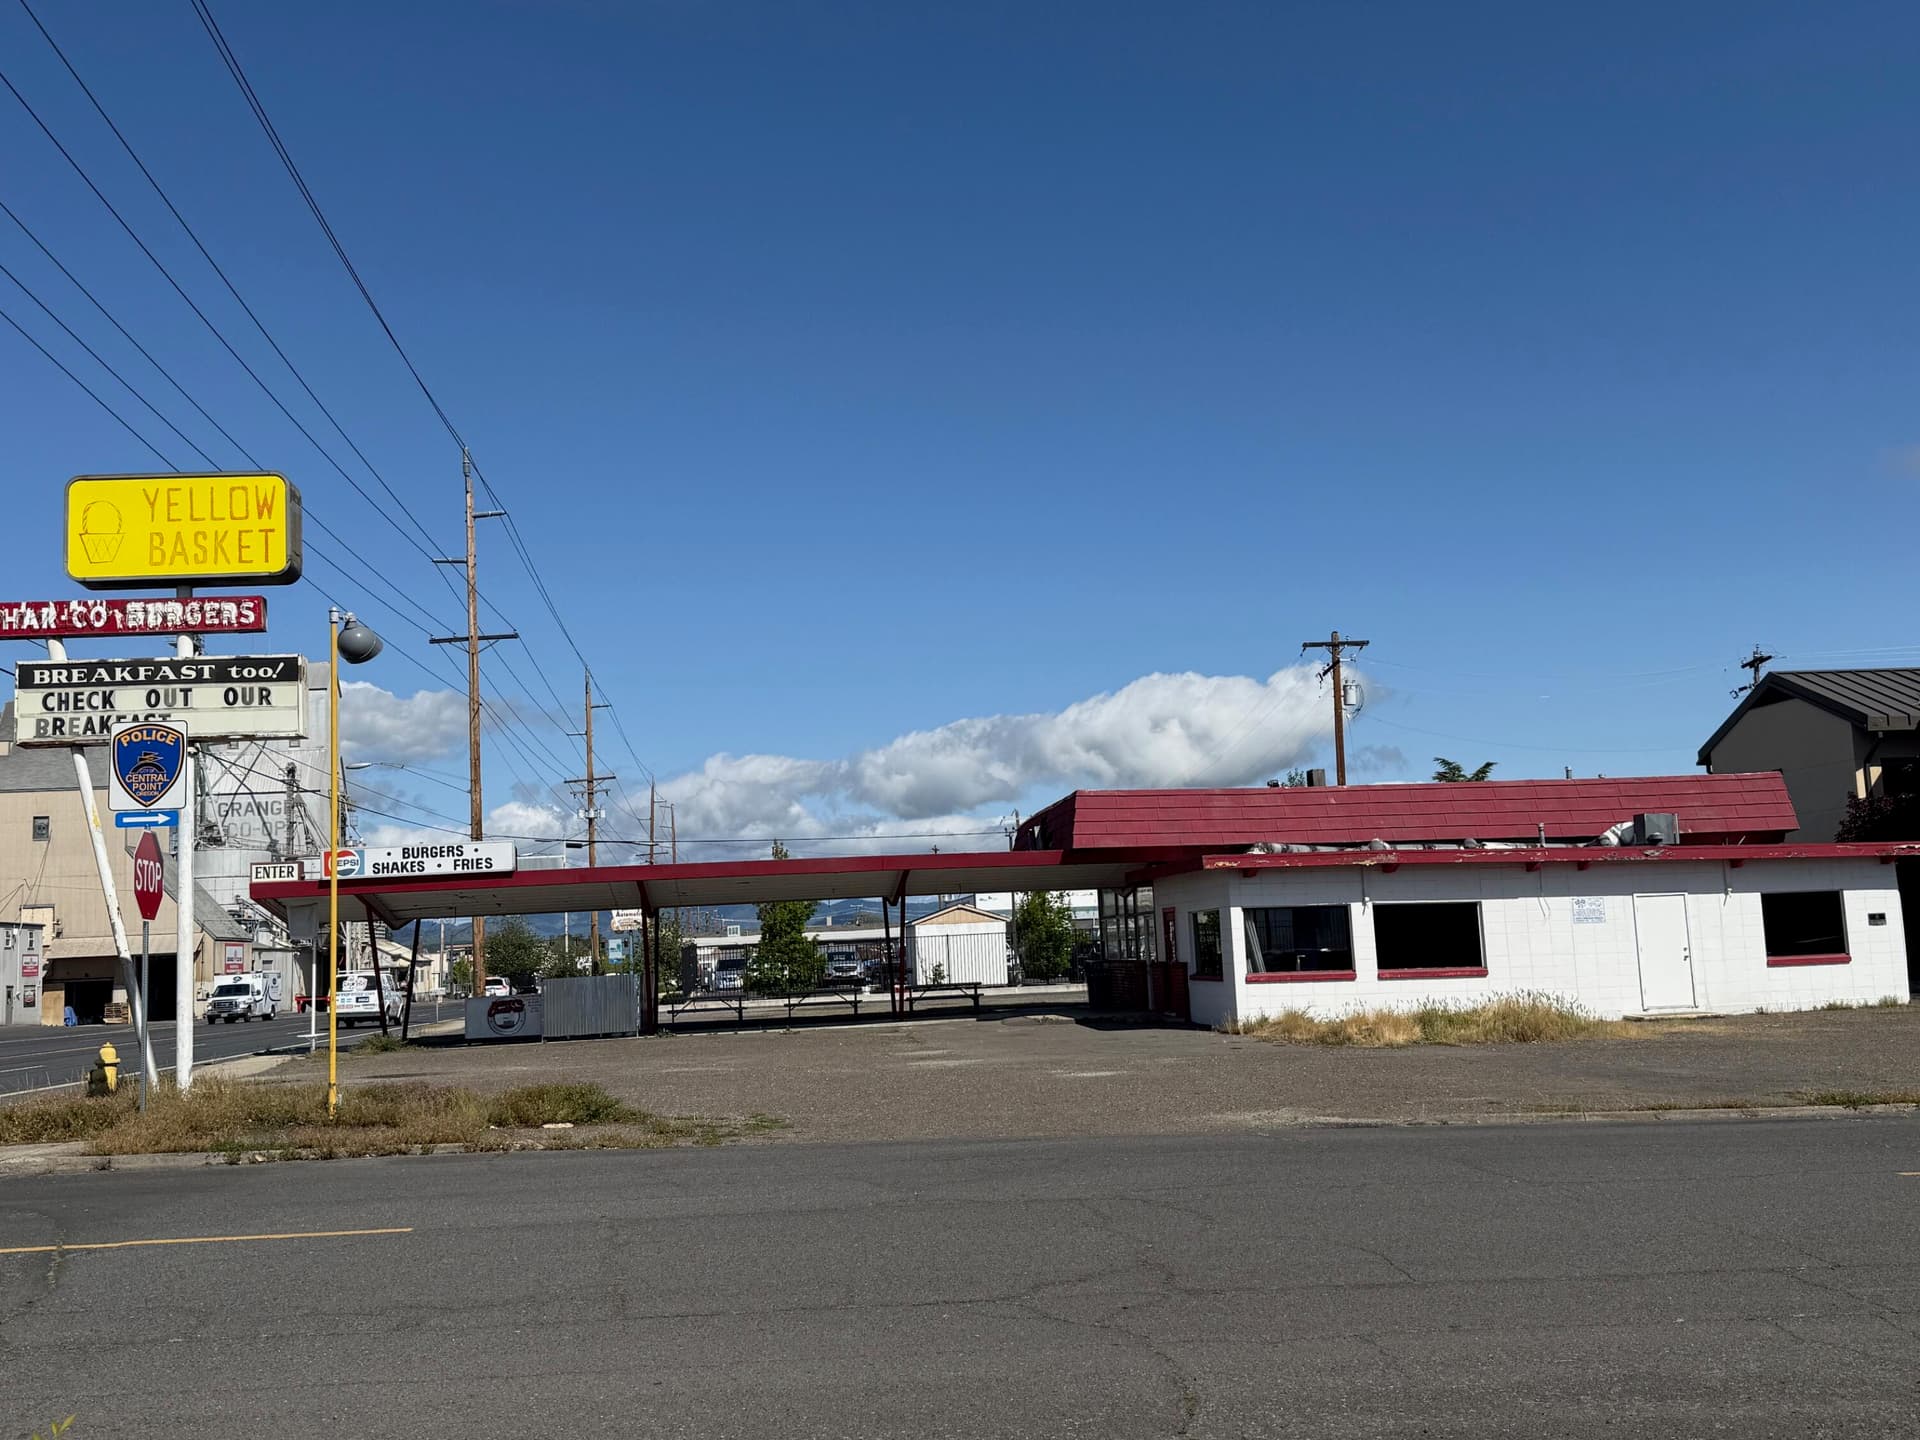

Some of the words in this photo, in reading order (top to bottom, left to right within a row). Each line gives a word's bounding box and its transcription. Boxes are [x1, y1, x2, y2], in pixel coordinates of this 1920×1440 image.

[143, 485, 277, 522] YELLOW
[150, 528, 275, 567] BASKET
[0, 605, 107, 630] HAR-CO
[33, 664, 216, 685] BREAKFAST
[227, 662, 285, 679] too!
[41, 689, 115, 711] CHECK
[145, 688, 193, 708] OUT
[223, 686, 272, 706] OUR
[120, 729, 178, 747] POLICE
[125, 773, 170, 782] CENTRAL
[133, 783, 163, 792] POINT
[228, 821, 286, 837] CO-OP
[402, 845, 464, 859] BURGERS
[336, 859, 359, 867] EPSI
[372, 860, 425, 874] SHAKES
[453, 857, 493, 871] FRIES
[136, 858, 162, 893] STOP
[255, 865, 295, 880] ENTER
